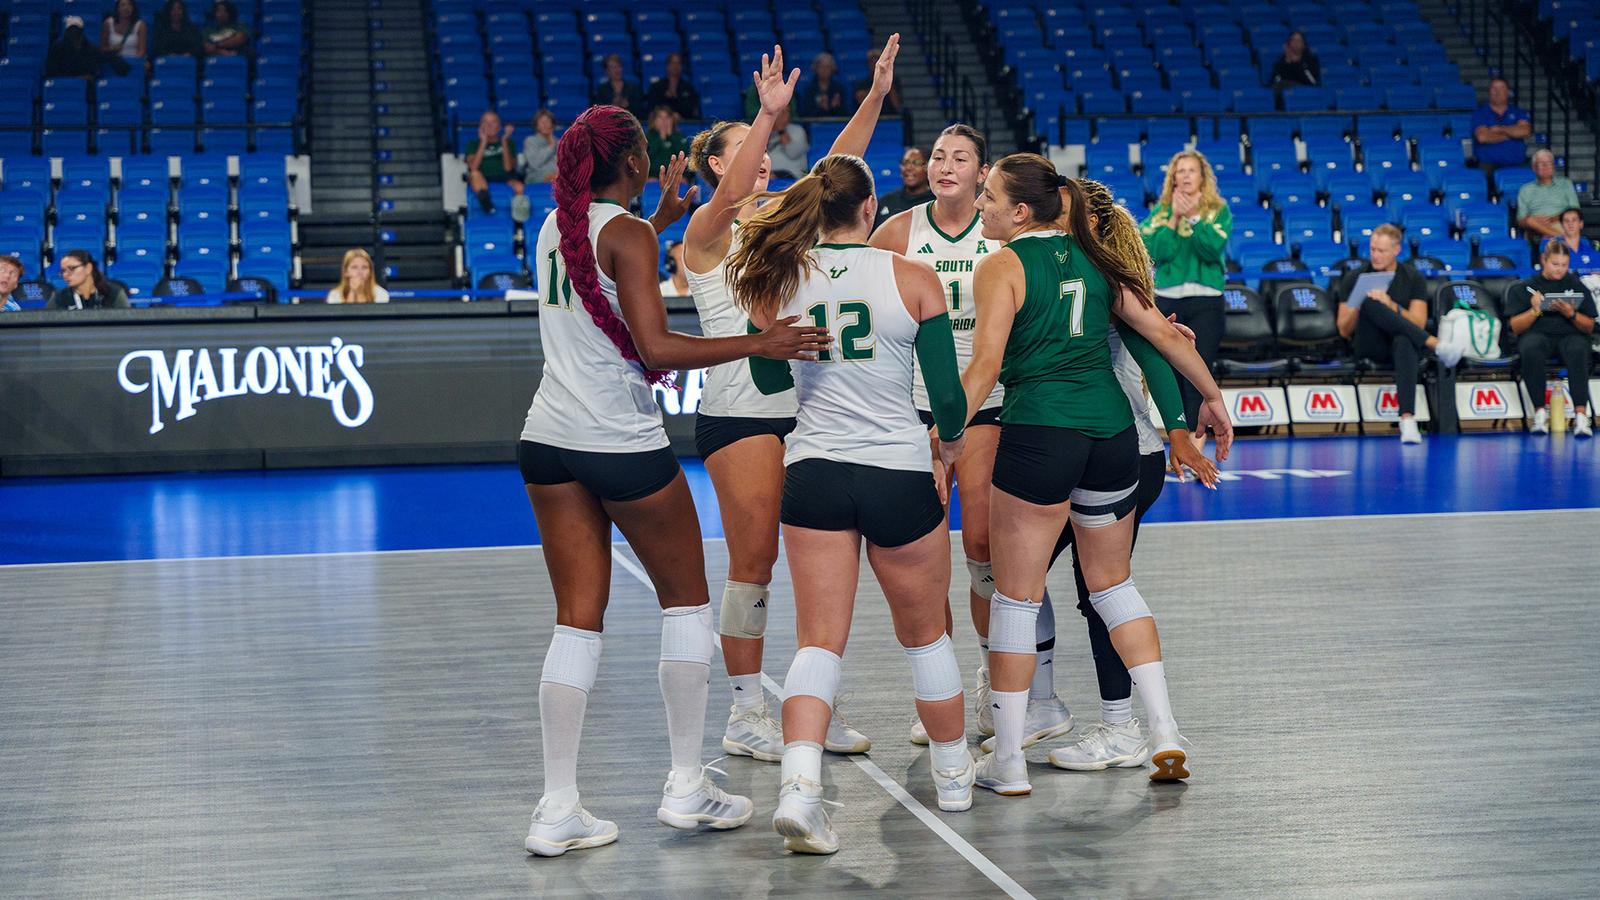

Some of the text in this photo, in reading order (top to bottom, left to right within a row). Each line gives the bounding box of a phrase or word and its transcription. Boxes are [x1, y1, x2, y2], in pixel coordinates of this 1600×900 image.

[935, 259, 974, 273] SOUTH
[946, 279, 964, 312] 1
[1060, 278, 1087, 338] 7
[806, 299, 877, 363] 12
[950, 318, 977, 331] RIDA
[117, 336, 375, 435] MALONE'S
